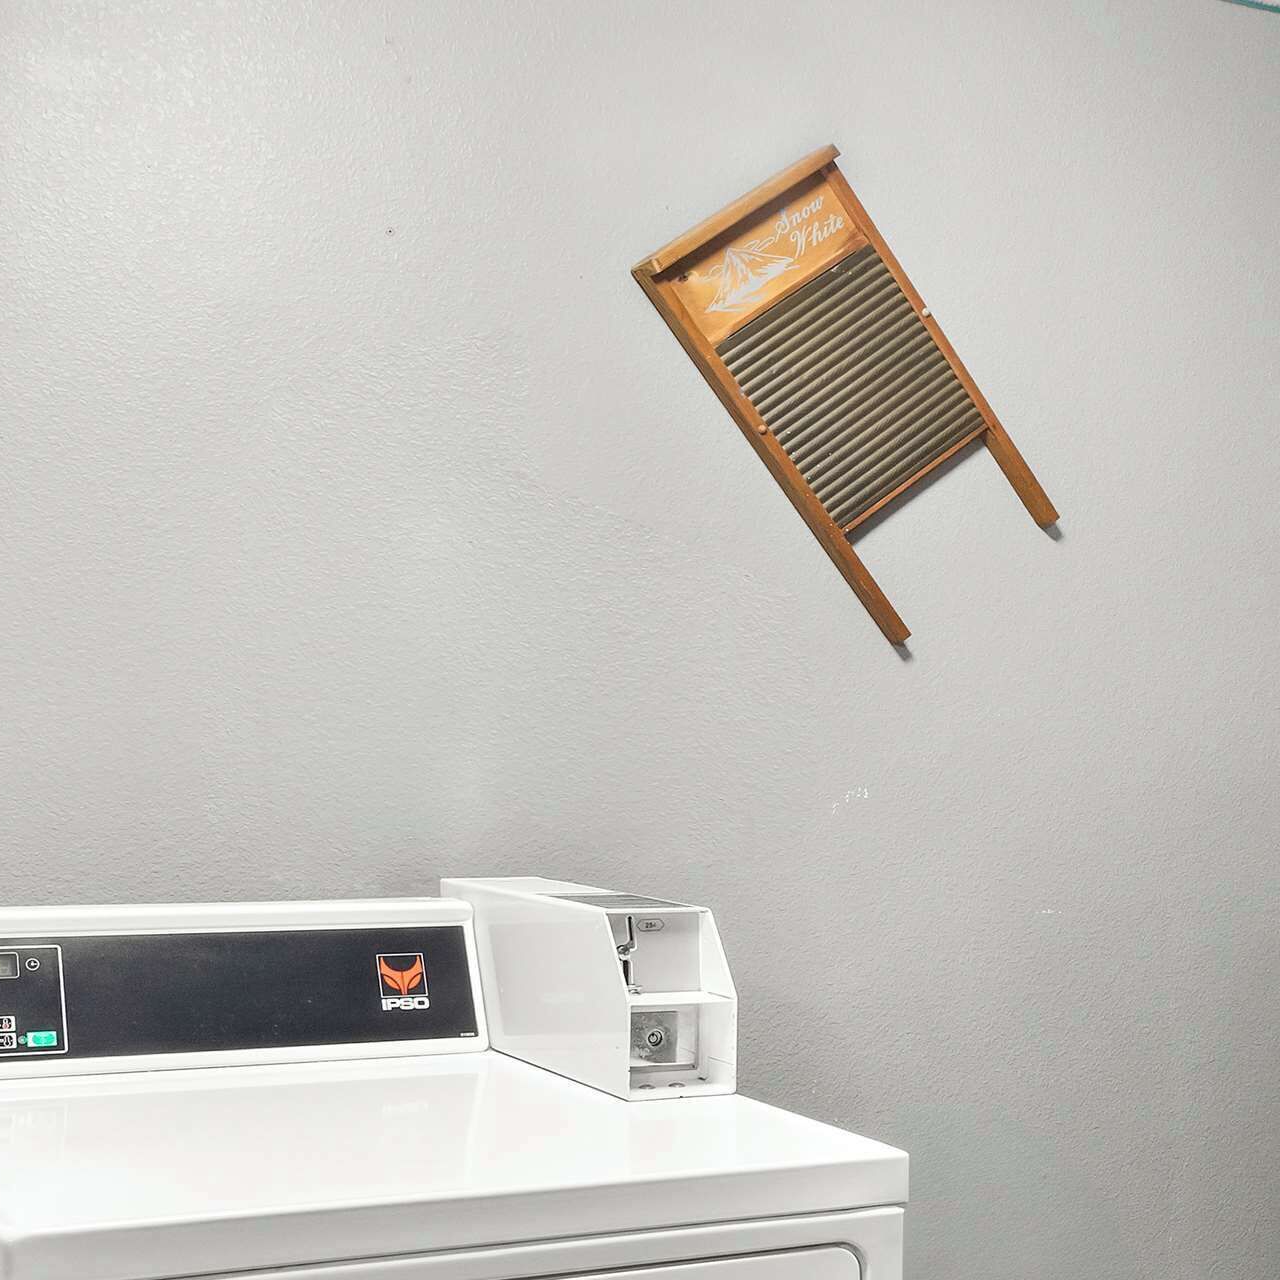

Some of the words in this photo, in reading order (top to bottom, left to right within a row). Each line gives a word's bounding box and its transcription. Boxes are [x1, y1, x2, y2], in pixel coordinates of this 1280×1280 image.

[775, 194, 824, 243] Snow
[790, 213, 845, 260] White
[381, 997, 430, 1011] IPSO
